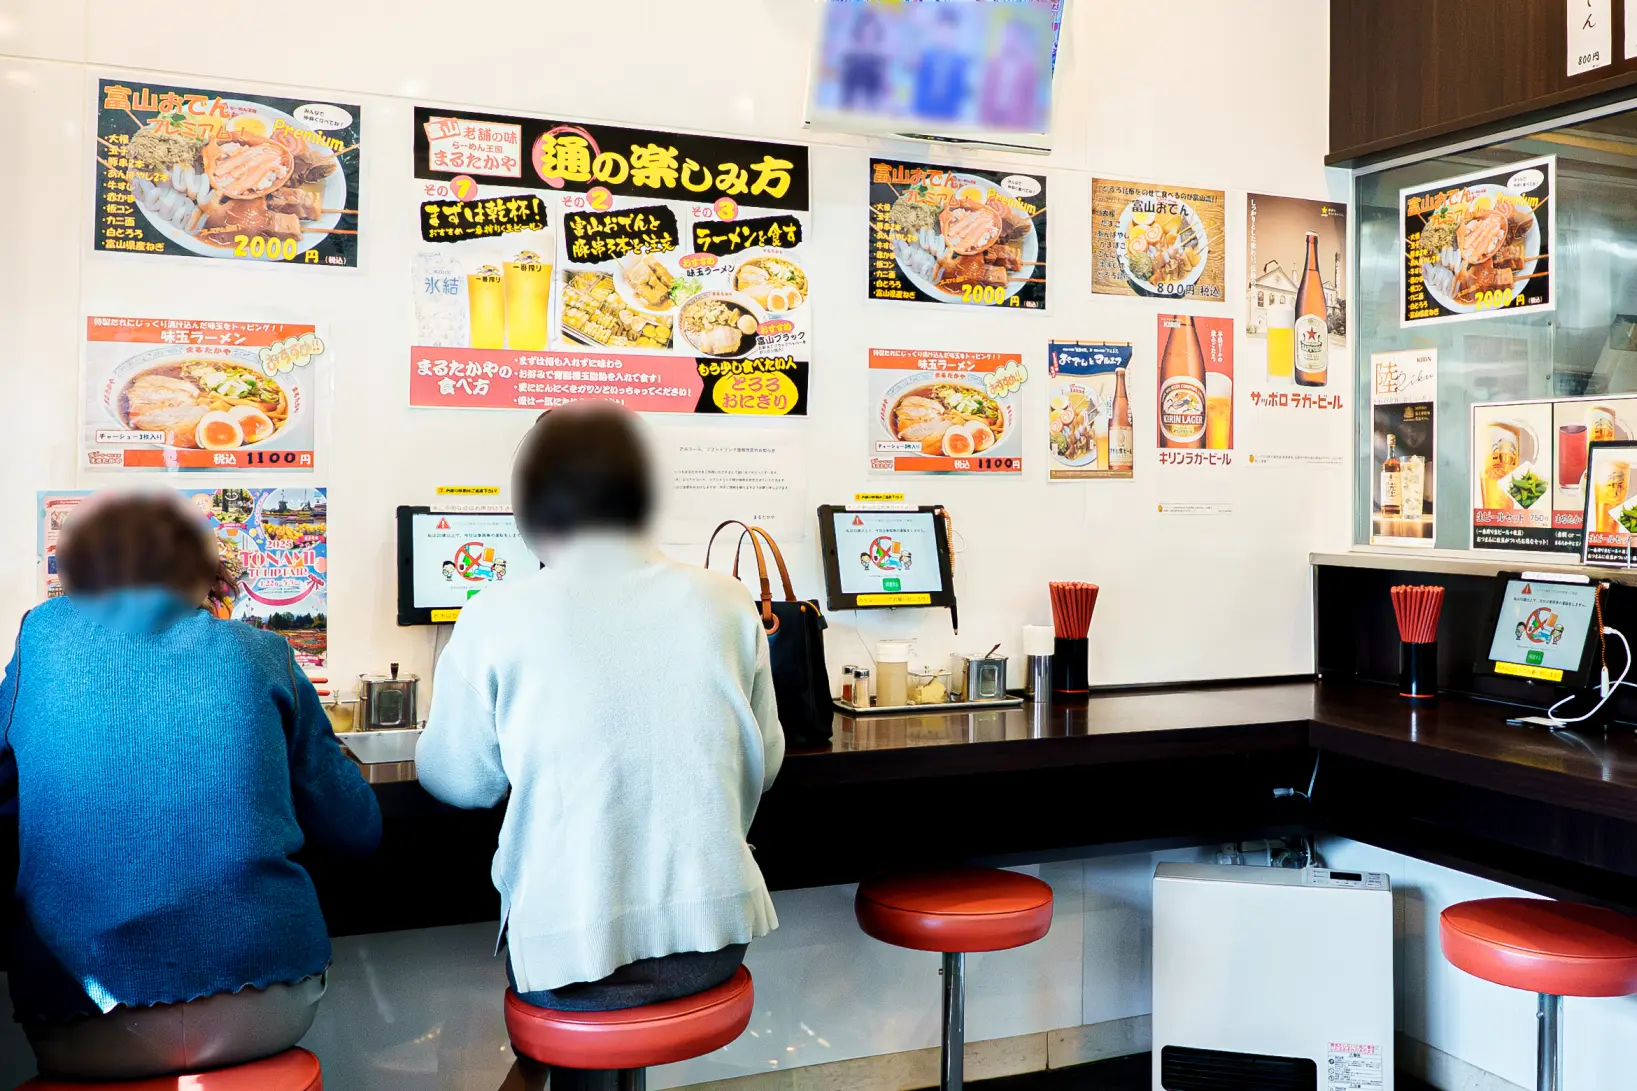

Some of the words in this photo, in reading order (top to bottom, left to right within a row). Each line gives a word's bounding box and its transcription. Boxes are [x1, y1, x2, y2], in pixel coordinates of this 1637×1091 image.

[1578, 51, 1600, 65] 800円
[104, 85, 232, 118] 富山おでん
[304, 108, 325, 117] みんなで
[273, 119, 345, 151] Premium
[464, 126, 517, 144] 老舗の味
[452, 141, 503, 153] らーめん王国
[434, 149, 517, 172] まるたかや
[540, 133, 794, 199] 通の楽しみ方
[873, 163, 959, 188] 富山おでん
[988, 188, 1037, 214] Premium
[1407, 187, 1471, 216] 富山おでん
[1495, 191, 1539, 208] Premium
[424, 198, 540, 226] まずは乾杯！
[1131, 200, 1189, 217] 富山おでん
[570, 212, 661, 236] 富山おでんと
[429, 227, 464, 238] おすすめ
[696, 221, 797, 251] ラーメンを食す
[572, 232, 677, 257] 豚串3本を注文
[513, 264, 542, 272] 一番搾り
[682, 256, 716, 267] おすすめ
[687, 265, 736, 277] 味玉ラーメン
[425, 276, 459, 295] 氷結
[1157, 283, 1195, 296] 800円
[1200, 285, 1219, 297] 税込
[760, 322, 792, 334] おすすめ
[160, 329, 246, 345] 味玉ラーメン
[757, 331, 805, 345] 富山ブラック
[186, 346, 231, 355] まるたかや
[417, 358, 512, 378] まるたかやの
[698, 356, 797, 376] もう少し食べたい人
[918, 359, 975, 371] 味玉ラーメン
[438, 377, 490, 395] 食べ方
[732, 376, 780, 392] とろろ
[1376, 362, 1397, 395] 陸
[723, 394, 787, 410] おにぎり
[1163, 414, 1181, 423] KIRIN
[1182, 414, 1202, 424] LAGER
[213, 453, 236, 465] 税込
[954, 460, 970, 469] 税込
[1159, 452, 1231, 465] キリンラガービール
[1476, 511, 1524, 523] 生ビールセット
[266, 540, 293, 549] 2025
[240, 550, 315, 567] TONAMI
[248, 567, 281, 578] TULIP
[283, 567, 308, 577] FAIR
